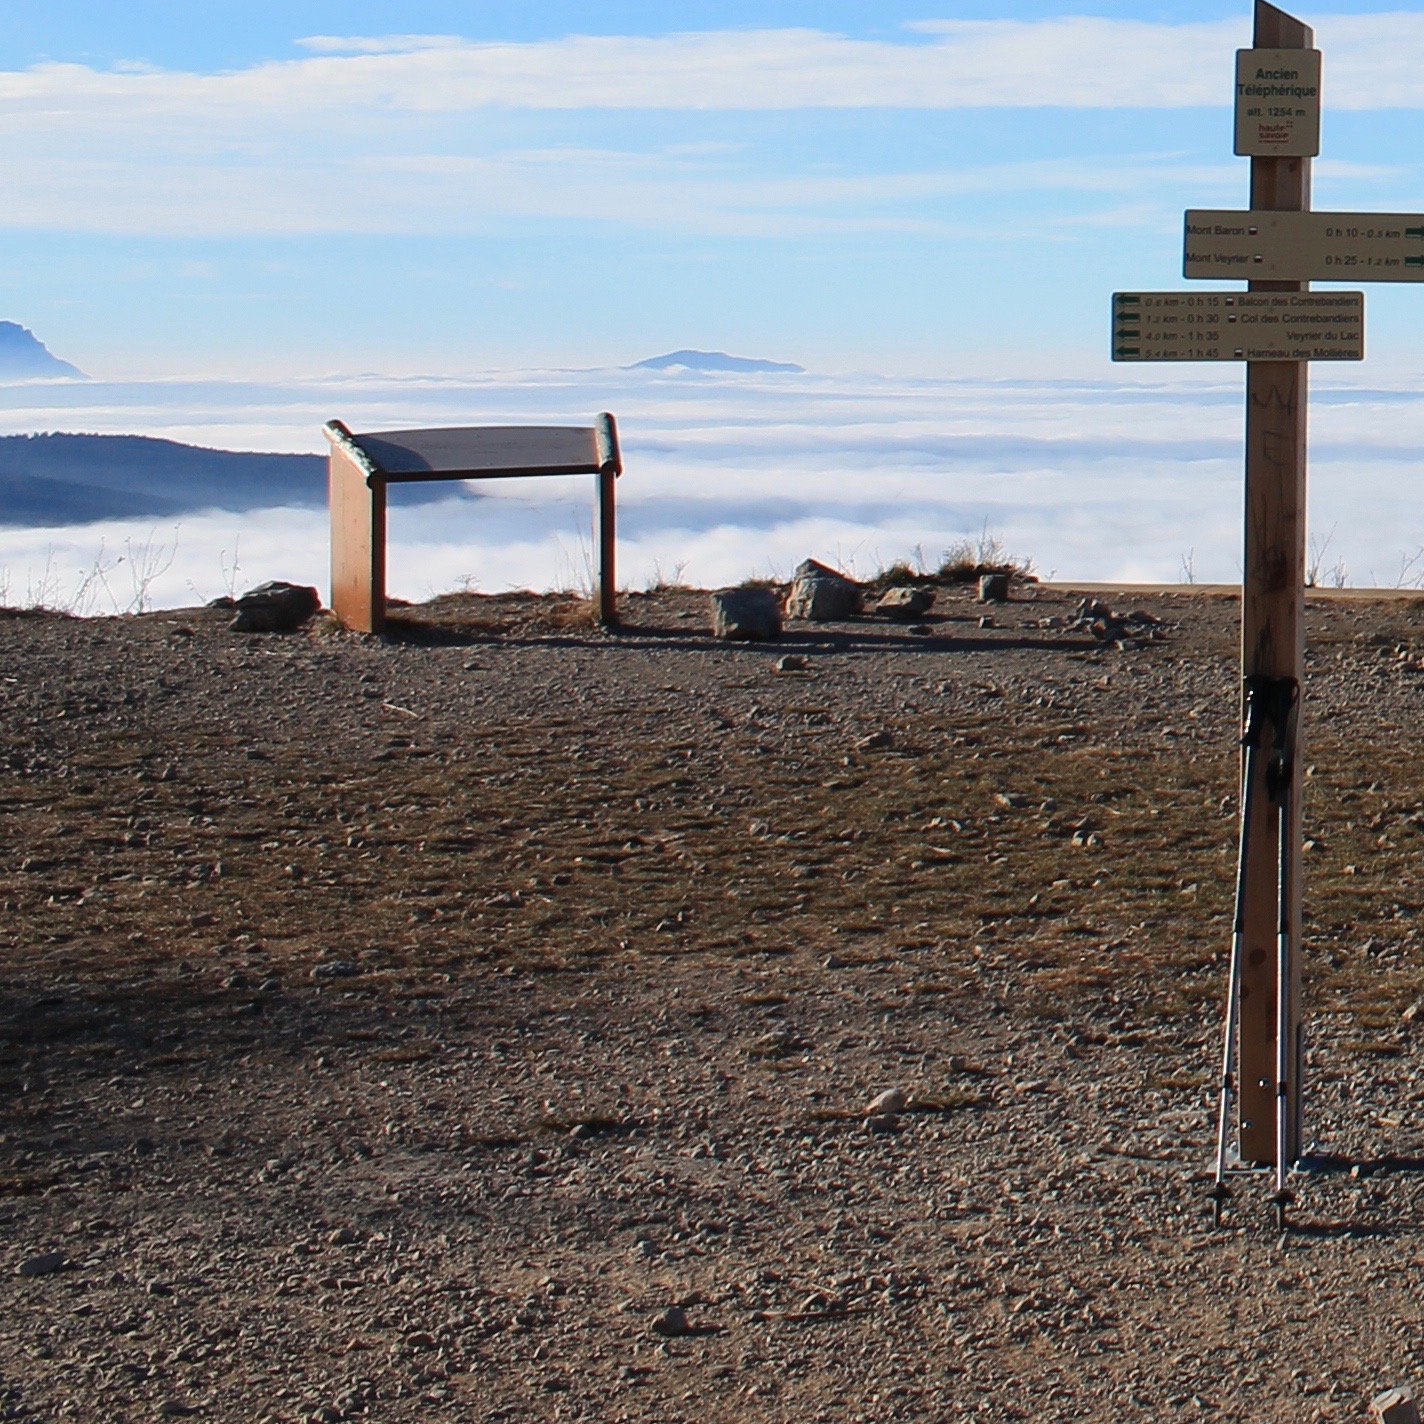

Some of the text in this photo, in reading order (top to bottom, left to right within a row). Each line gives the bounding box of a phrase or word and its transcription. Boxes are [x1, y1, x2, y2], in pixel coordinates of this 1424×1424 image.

[1255, 68, 1299, 80] Ancien
[1237, 83, 1317, 100] Téléphérique
[1247, 107, 1306, 117] alt. 1254 m
[1258, 123, 1286, 132] haute
[1187, 225, 1245, 235] Mont Baron
[1326, 228, 1333, 238] 0
[1336, 228, 1342, 238] h
[1346, 228, 1358, 238] 10
[1385, 229, 1401, 239] km
[1186, 252, 1249, 265] Mont Veyrier
[1325, 255, 1333, 265] 0
[1334, 255, 1342, 265] h
[1344, 255, 1357, 266] 25
[1384, 257, 1400, 267] km
[1164, 298, 1179, 307] km
[1187, 297, 1195, 307] 0
[1197, 297, 1204, 307] h
[1207, 296, 1220, 307] 15
[1237, 296, 1359, 307] Balcon des Contrebandiers
[1163, 314, 1178, 324] km
[1187, 314, 1195, 324] 0
[1197, 314, 1204, 324] h
[1206, 314, 1220, 324] 30
[1241, 313, 1360, 324] Col des Contrebandiers
[1163, 331, 1178, 341] km
[1187, 331, 1193, 341] 1
[1197, 331, 1204, 341] h
[1206, 331, 1220, 341] 35
[1286, 331, 1359, 343] Veyrier du Lac
[1163, 349, 1178, 358] km
[1187, 348, 1193, 358] 1
[1197, 348, 1204, 358] h
[1206, 348, 1219, 358] 45
[1247, 348, 1290, 358] Hameau
[1292, 348, 1311, 358] des
